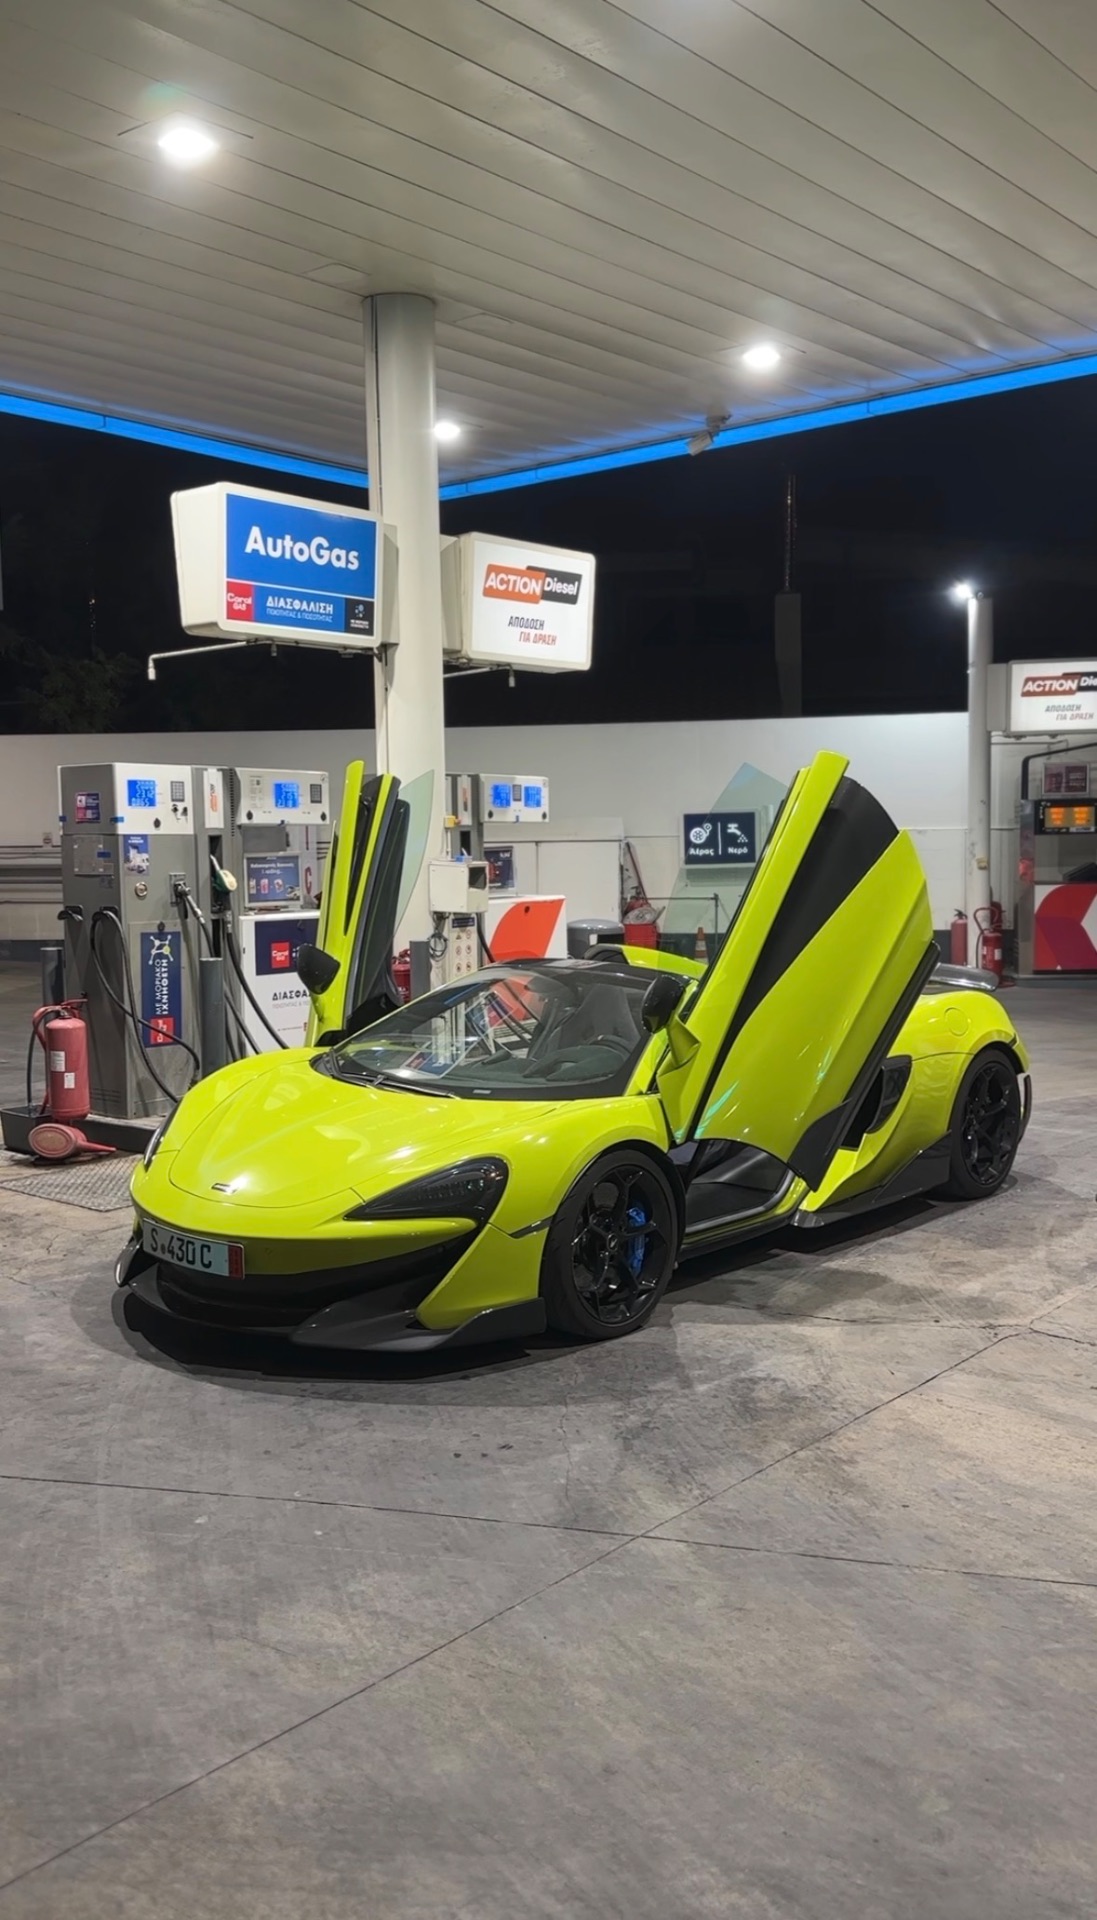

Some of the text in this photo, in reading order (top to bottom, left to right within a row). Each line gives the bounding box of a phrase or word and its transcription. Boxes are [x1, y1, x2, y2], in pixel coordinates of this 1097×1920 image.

[245, 526, 359, 570] AutoGas
[486, 572, 578, 596] ACTION Diesel
[227, 592, 252, 604] Coral
[266, 595, 333, 614] ΔΙΑΣΦΑΛΙΣΗ
[508, 615, 545, 631] ΑΠΟΔΟΣΗ
[519, 631, 557, 646] ΓΙΑ ΔΡΑΣΗ
[1023, 679, 1078, 693] ACTION
[272, 989, 310, 1001] ΔΙΑΣΦΑ
